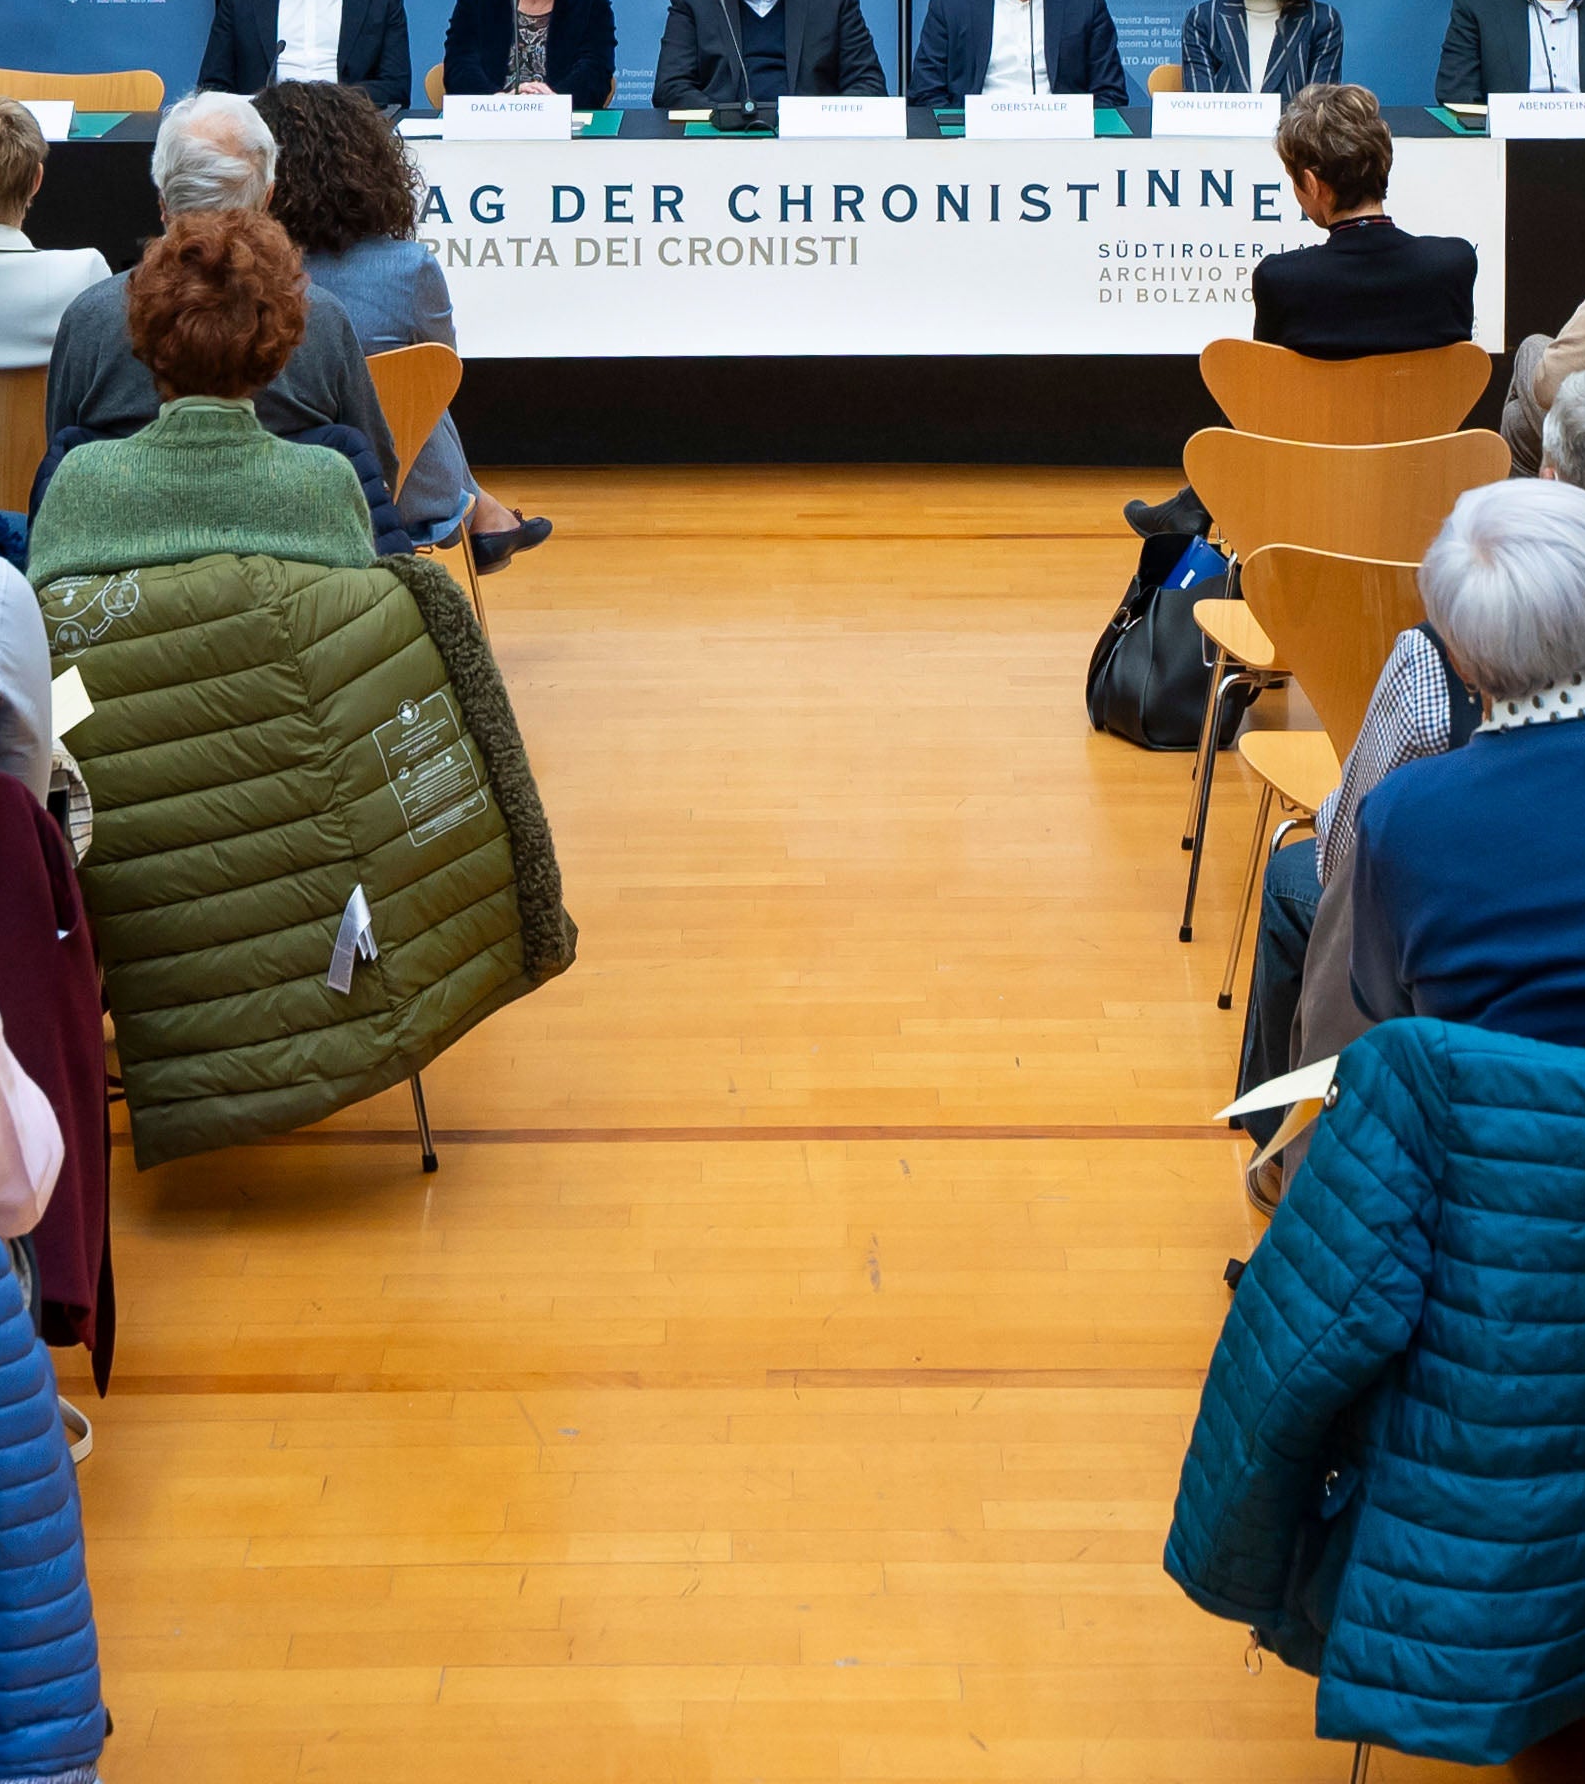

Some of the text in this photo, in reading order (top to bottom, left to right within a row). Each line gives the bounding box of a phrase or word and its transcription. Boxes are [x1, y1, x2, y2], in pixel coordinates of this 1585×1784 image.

[1144, 16, 1170, 24] Bozen
[1141, 56, 1170, 65] ADIGE
[471, 103, 544, 112] DALLA TORRE
[821, 104, 863, 112] PFEIFER
[991, 102, 1068, 112] OBERSTALLER
[1170, 101, 1262, 109] VON LUTTEROTTI
[418, 168, 1309, 225] AG DER CHRONISTINNE
[574, 236, 642, 267] DEI
[658, 235, 859, 267] CRONISTI
[1098, 239, 1264, 259] SÜDTIROLER
[1099, 266, 1222, 282] ARCHIVIO
[1099, 287, 1253, 303] DI BOLZANO
